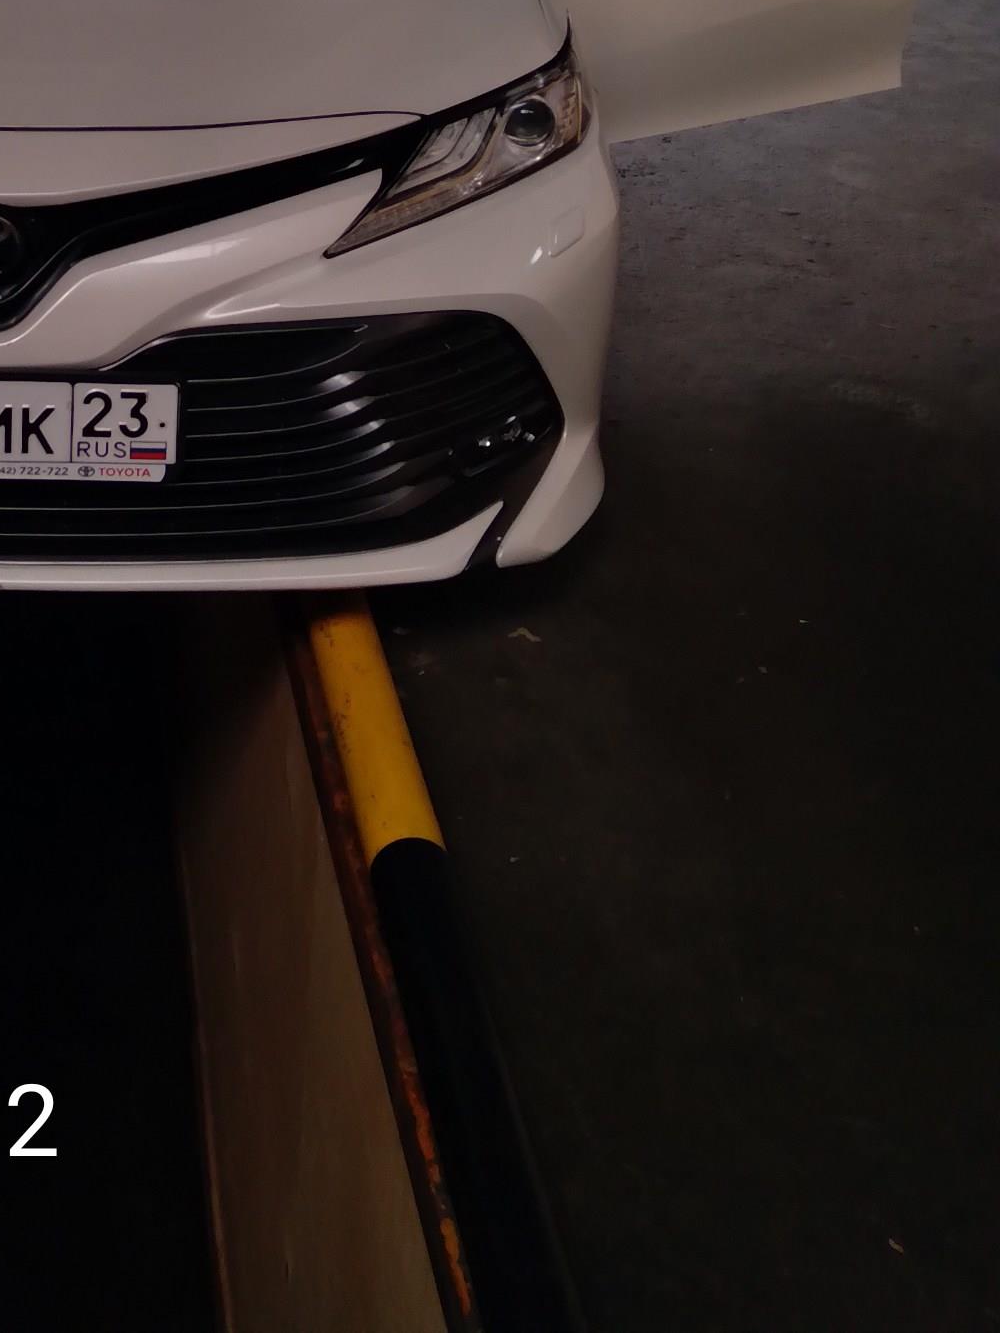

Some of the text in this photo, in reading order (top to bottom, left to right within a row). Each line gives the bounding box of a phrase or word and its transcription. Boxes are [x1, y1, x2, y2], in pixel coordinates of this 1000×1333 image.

[81, 390, 149, 439] 23
[76, 441, 127, 459] RUS
[20, 467, 69, 477] 722-722
[99, 467, 151, 478] TOYOTA
